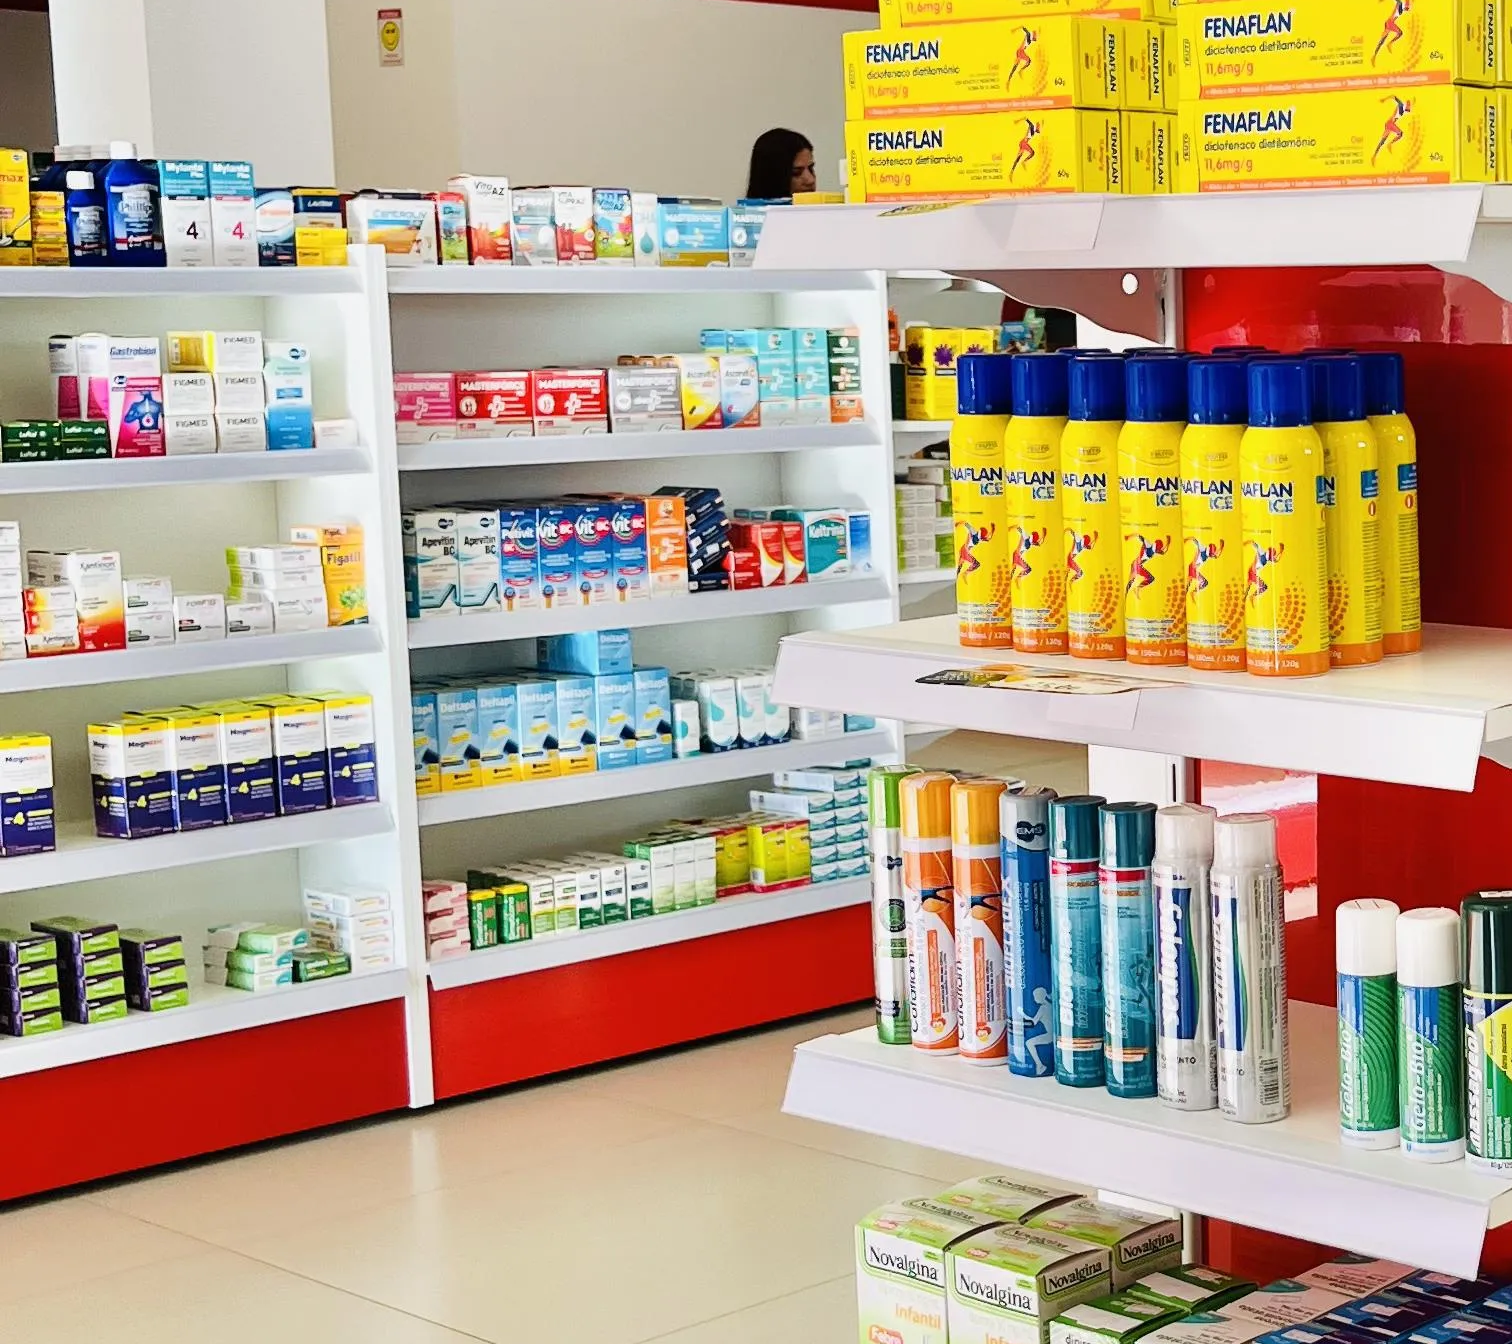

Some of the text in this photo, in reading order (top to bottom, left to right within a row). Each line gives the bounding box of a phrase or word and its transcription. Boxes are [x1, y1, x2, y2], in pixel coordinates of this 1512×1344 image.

[1204, 12, 1293, 38] FENAFLAN
[866, 41, 940, 64] FENAFLAN
[1108, 33, 1116, 92] FENAFLAN
[1205, 61, 1254, 76] 11,6mg/g
[1204, 110, 1293, 134] FENAFLAN
[868, 130, 943, 151] FENAFLAN
[1205, 158, 1253, 172] 11,6mg/g
[186, 221, 198, 239] 4
[232, 221, 244, 240] 4
[950, 467, 1003, 481] NAFLAN
[980, 483, 1003, 495] ICE
[1033, 486, 1055, 499] ICE
[1084, 489, 1106, 502] ICE
[1156, 493, 1179, 506] ICE
[1210, 497, 1233, 510] ICE
[1269, 499, 1293, 513] ICE
[443, 545, 455, 555] BC
[485, 543, 496, 554] BC
[414, 705, 434, 714] tapil
[1123, 1232, 1175, 1258] Novalgina
[870, 1246, 938, 1281] Novalgina
[1048, 1261, 1103, 1291] Novalgina
[960, 1274, 1031, 1310] Novalgina
